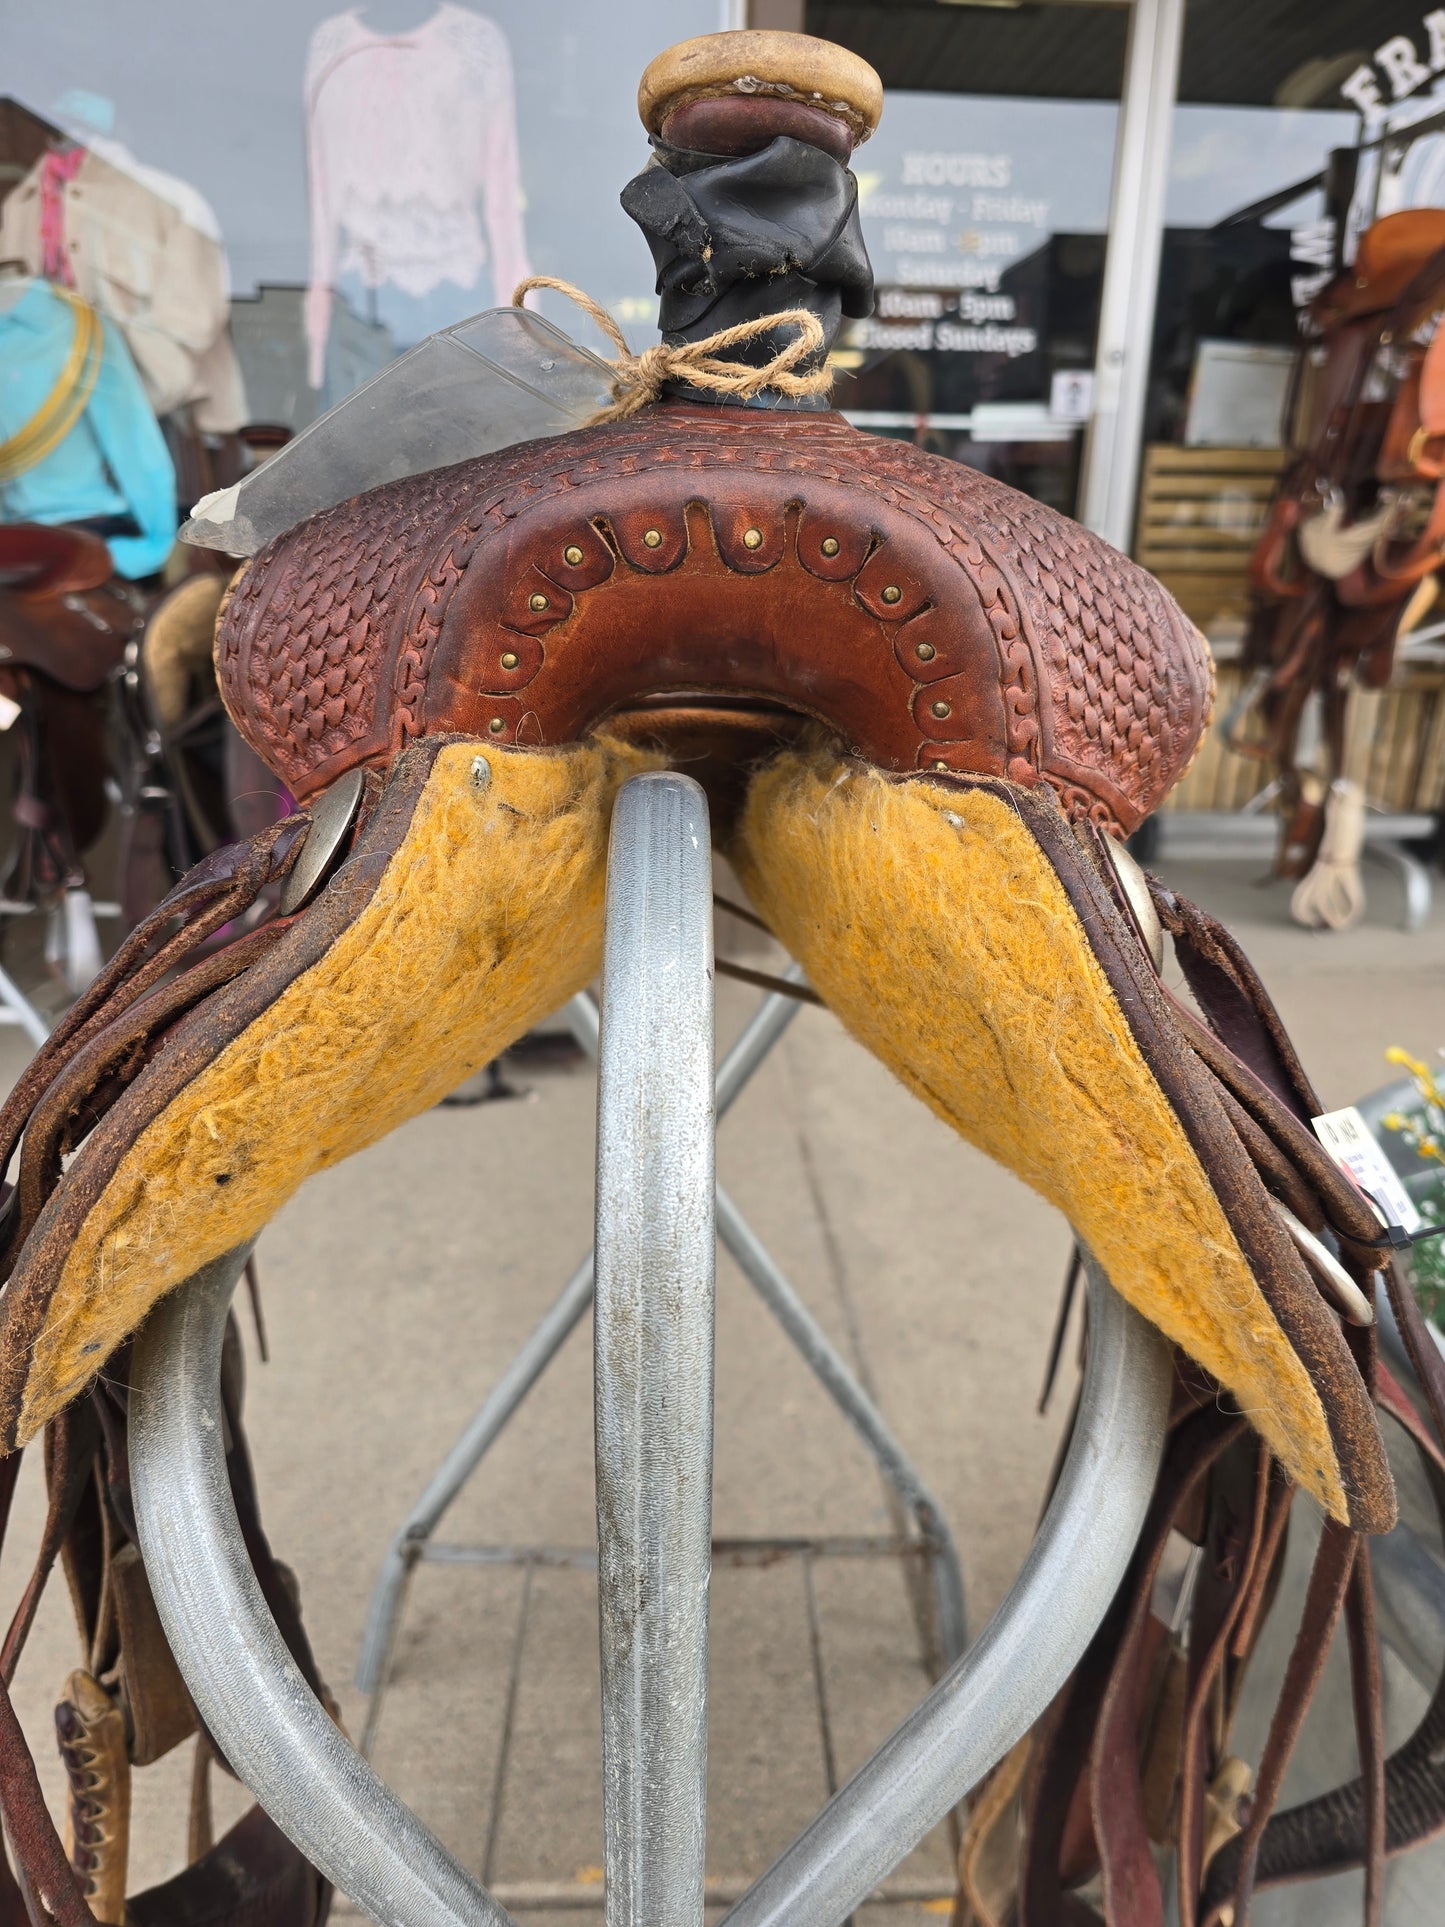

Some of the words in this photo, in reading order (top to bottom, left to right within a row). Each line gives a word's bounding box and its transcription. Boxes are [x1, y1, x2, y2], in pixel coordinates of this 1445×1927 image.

[902, 154, 1011, 188] HOURS
[971, 195, 1048, 228] Friday
[896, 257, 1001, 293] Saturday
[879, 292, 943, 319] 10am
[960, 294, 1016, 325] 5pm
[856, 320, 934, 351] Closed
[935, 324, 1038, 359] Sundays
